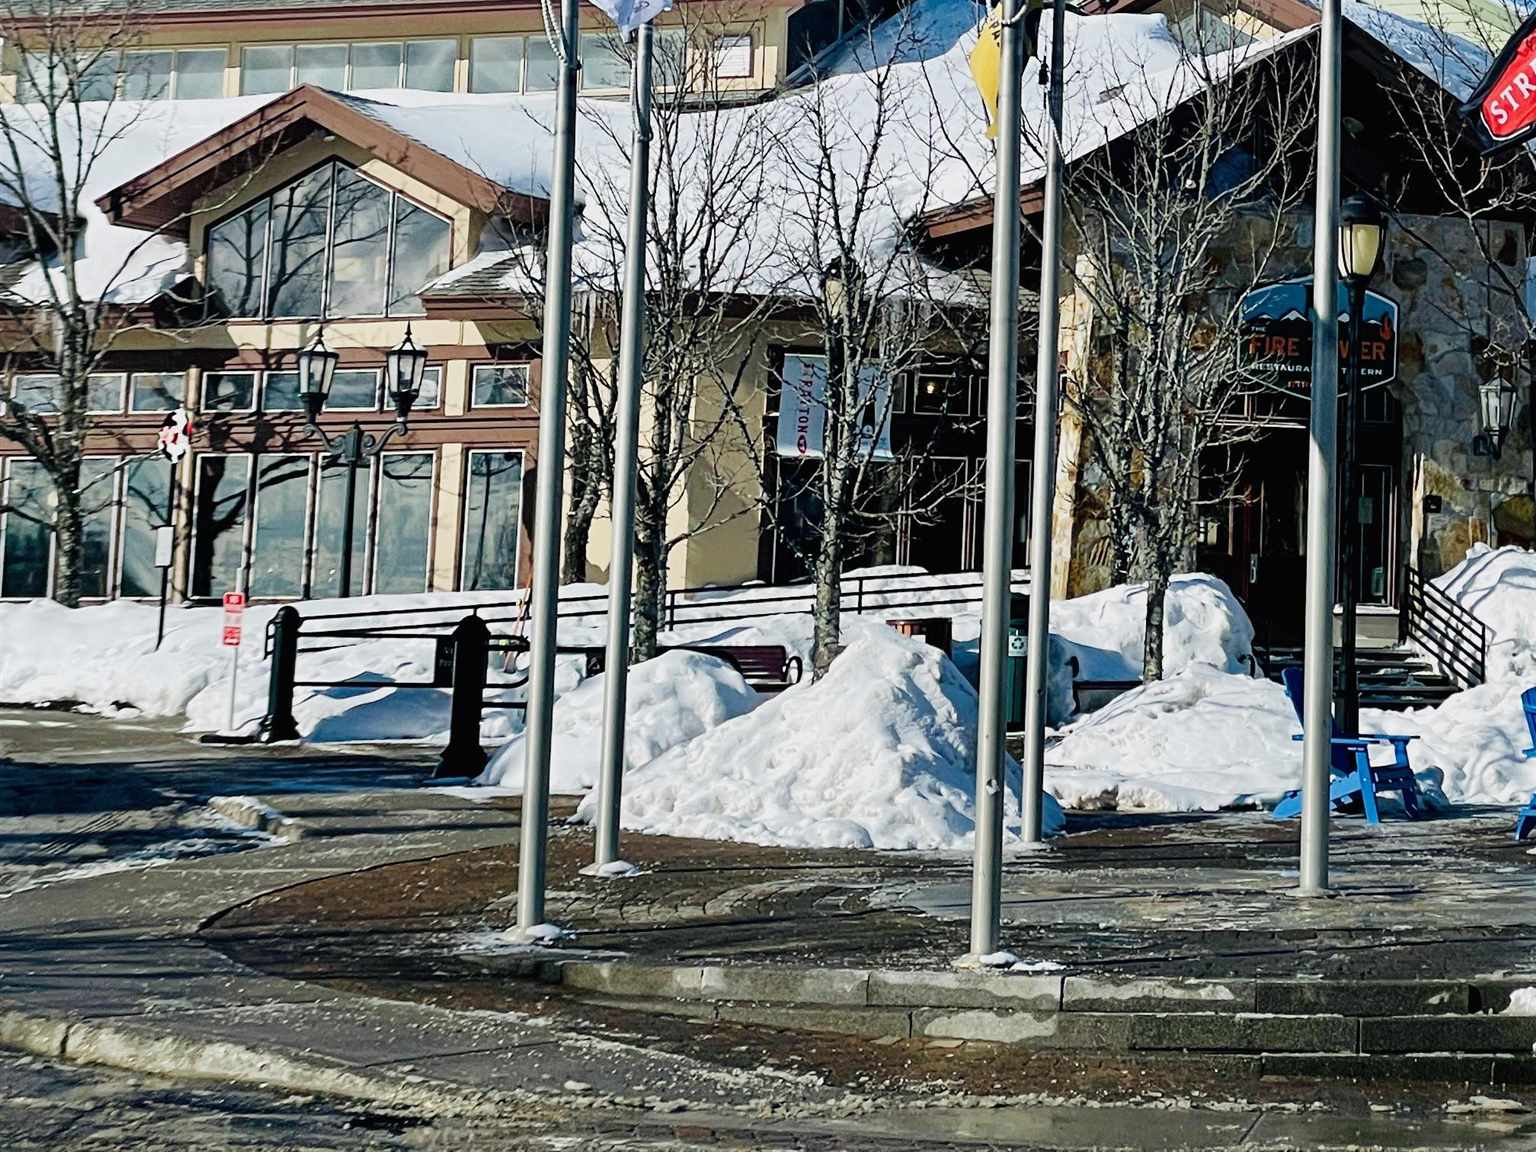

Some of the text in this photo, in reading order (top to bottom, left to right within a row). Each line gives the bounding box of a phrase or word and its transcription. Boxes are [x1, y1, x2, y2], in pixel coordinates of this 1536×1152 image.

[1248, 334, 1300, 357] FIRE
[1250, 362, 1383, 376] RESTAURA TERN
